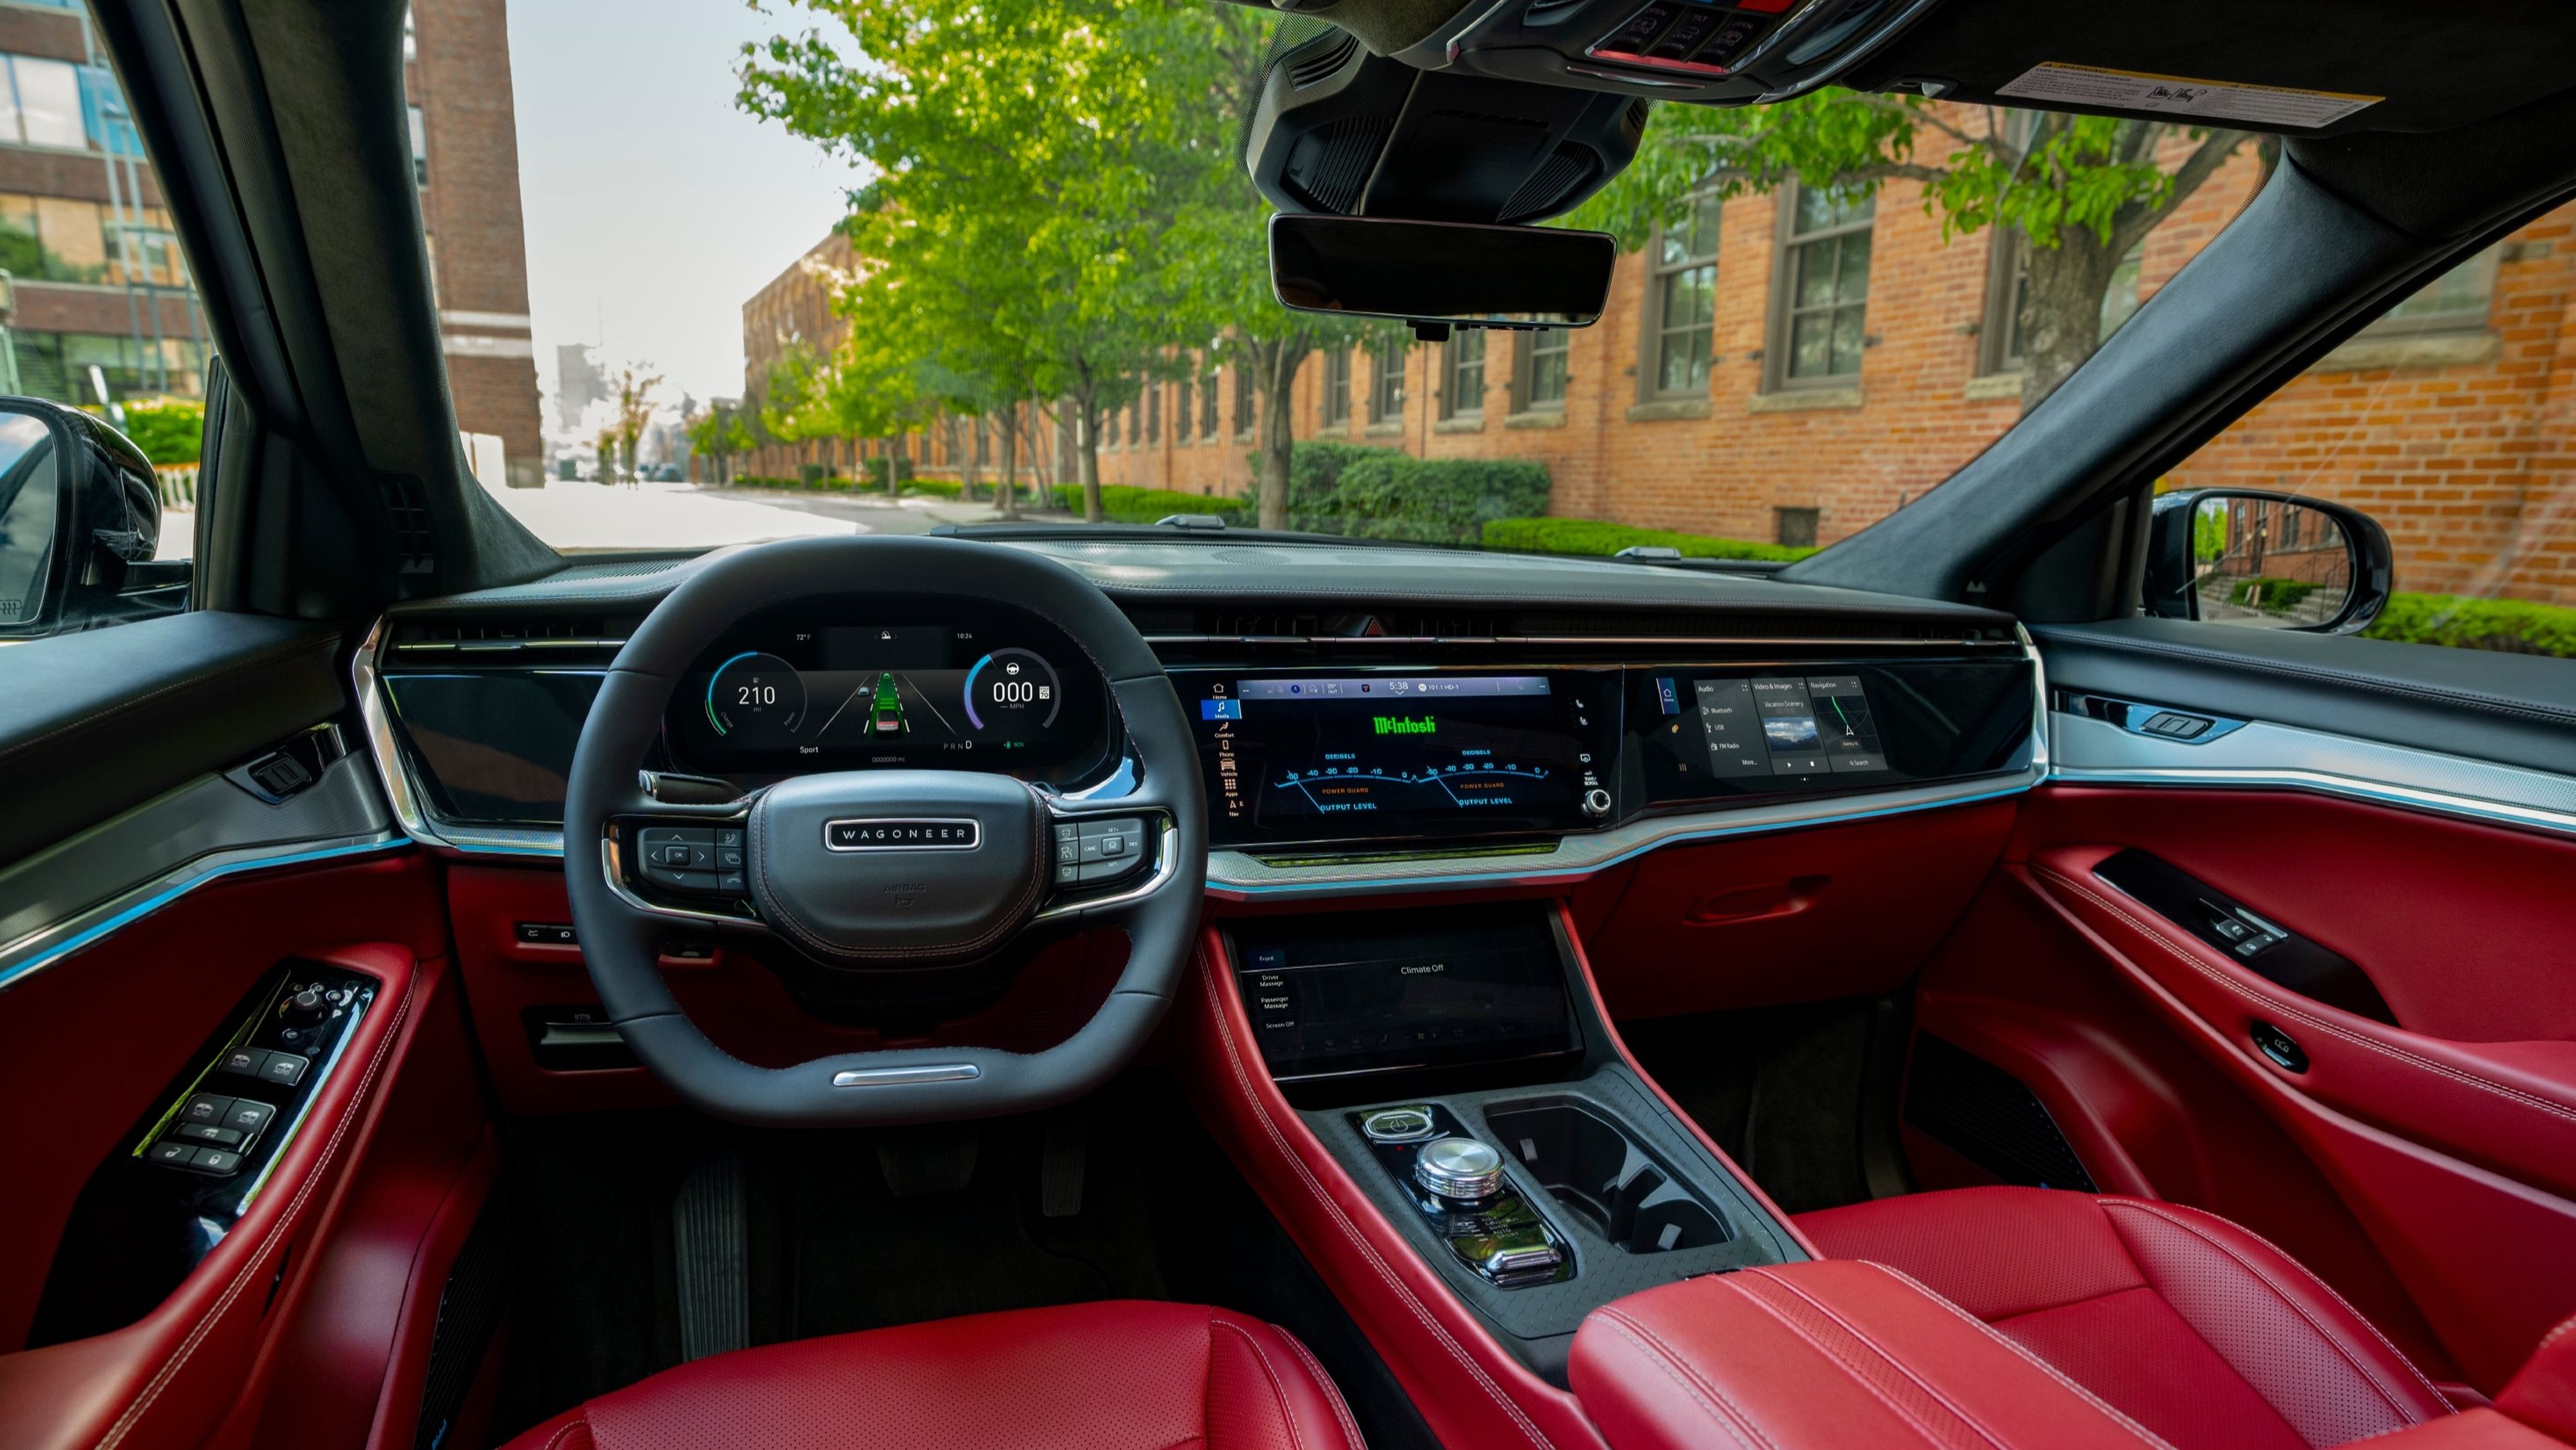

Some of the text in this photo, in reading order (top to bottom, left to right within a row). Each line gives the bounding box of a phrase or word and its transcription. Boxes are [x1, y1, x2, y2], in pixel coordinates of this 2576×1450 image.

[1389, 682, 1408, 690] 5:38
[739, 686, 775, 705] 210
[994, 682, 1033, 703] 000
[1784, 701, 1804, 709] Scenery
[1373, 716, 1435, 734] McIntosh
[965, 740, 972, 749] D
[800, 746, 818, 754] Sport
[843, 829, 965, 839] WAGONEER
[883, 884, 926, 894] AIRBAG
[1401, 964, 1444, 974] Climate Off
